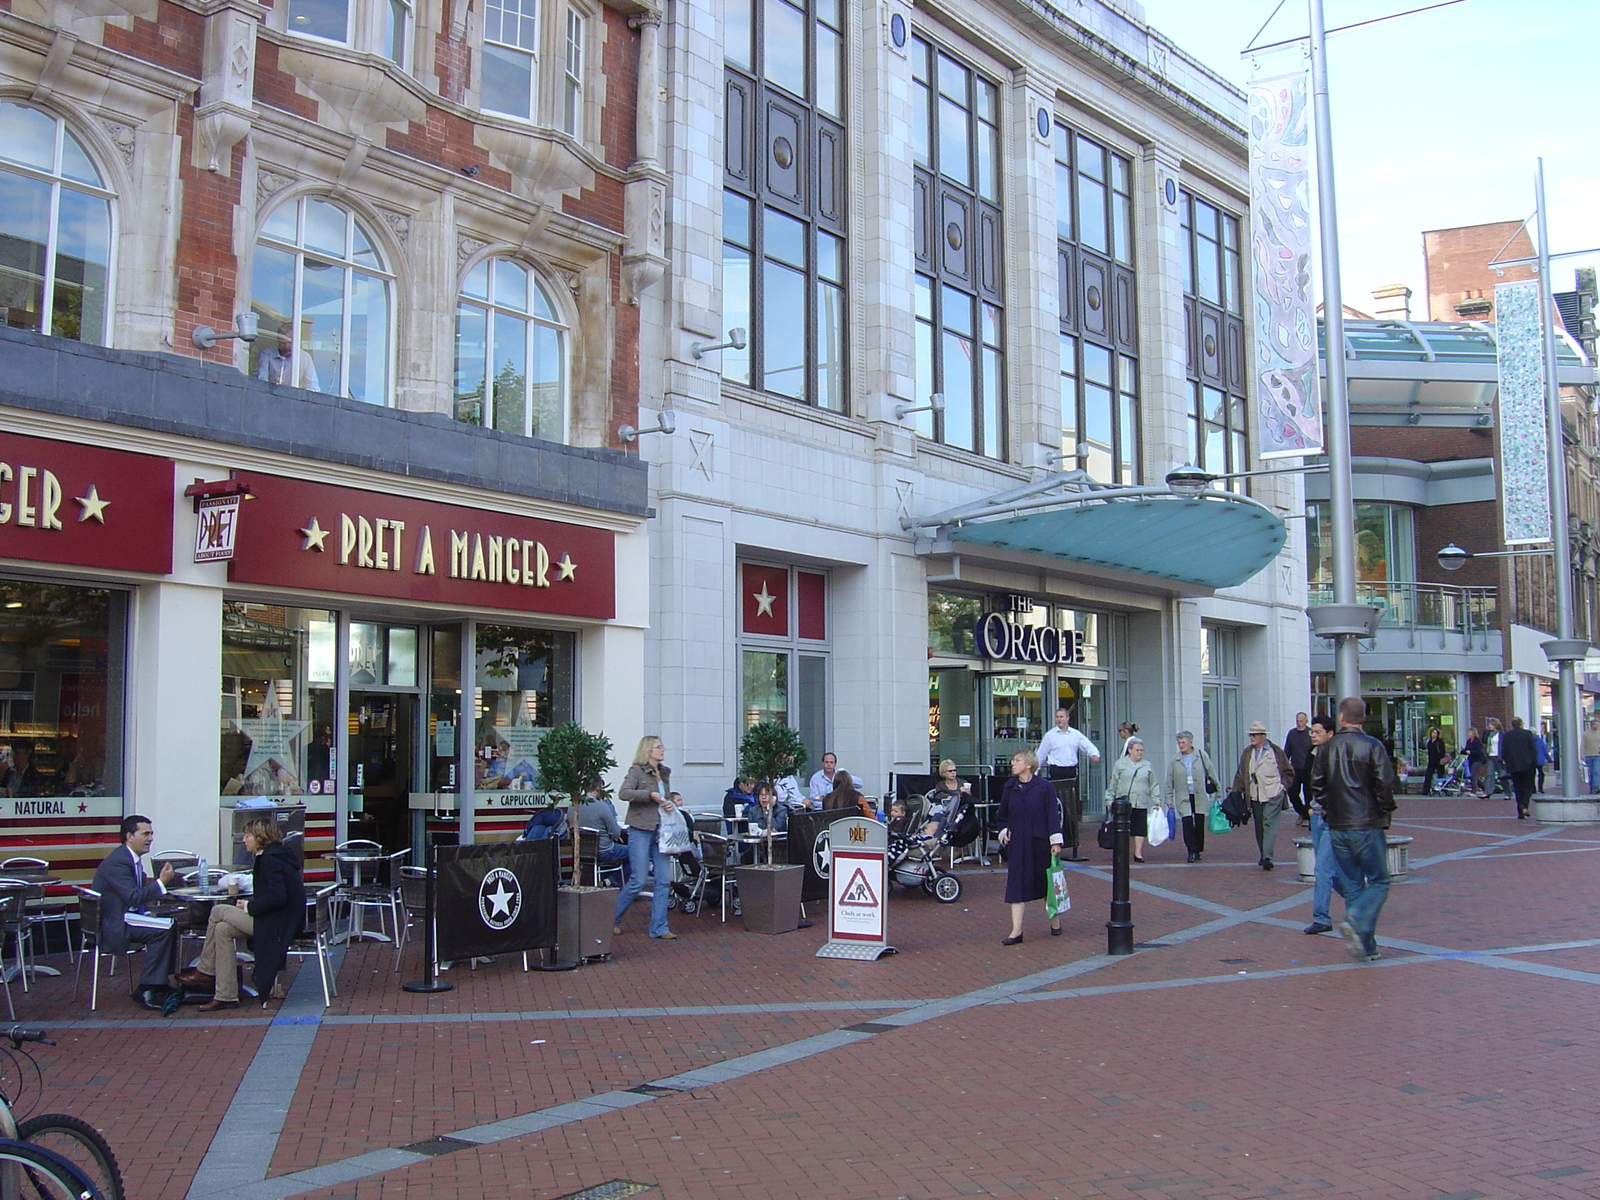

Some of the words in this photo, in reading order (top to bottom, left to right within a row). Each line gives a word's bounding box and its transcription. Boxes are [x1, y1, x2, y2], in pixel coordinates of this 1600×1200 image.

[198, 509, 236, 550] PRET
[338, 512, 405, 570] PRET
[414, 525, 435, 575] A
[450, 529, 550, 588] MANGER
[1009, 594, 1034, 612] THE
[980, 611, 1085, 664] ORACLE
[14, 801, 65, 815] NATURAL
[500, 795, 546, 806] CAPPUCCINO
[849, 827, 867, 841] PRET
